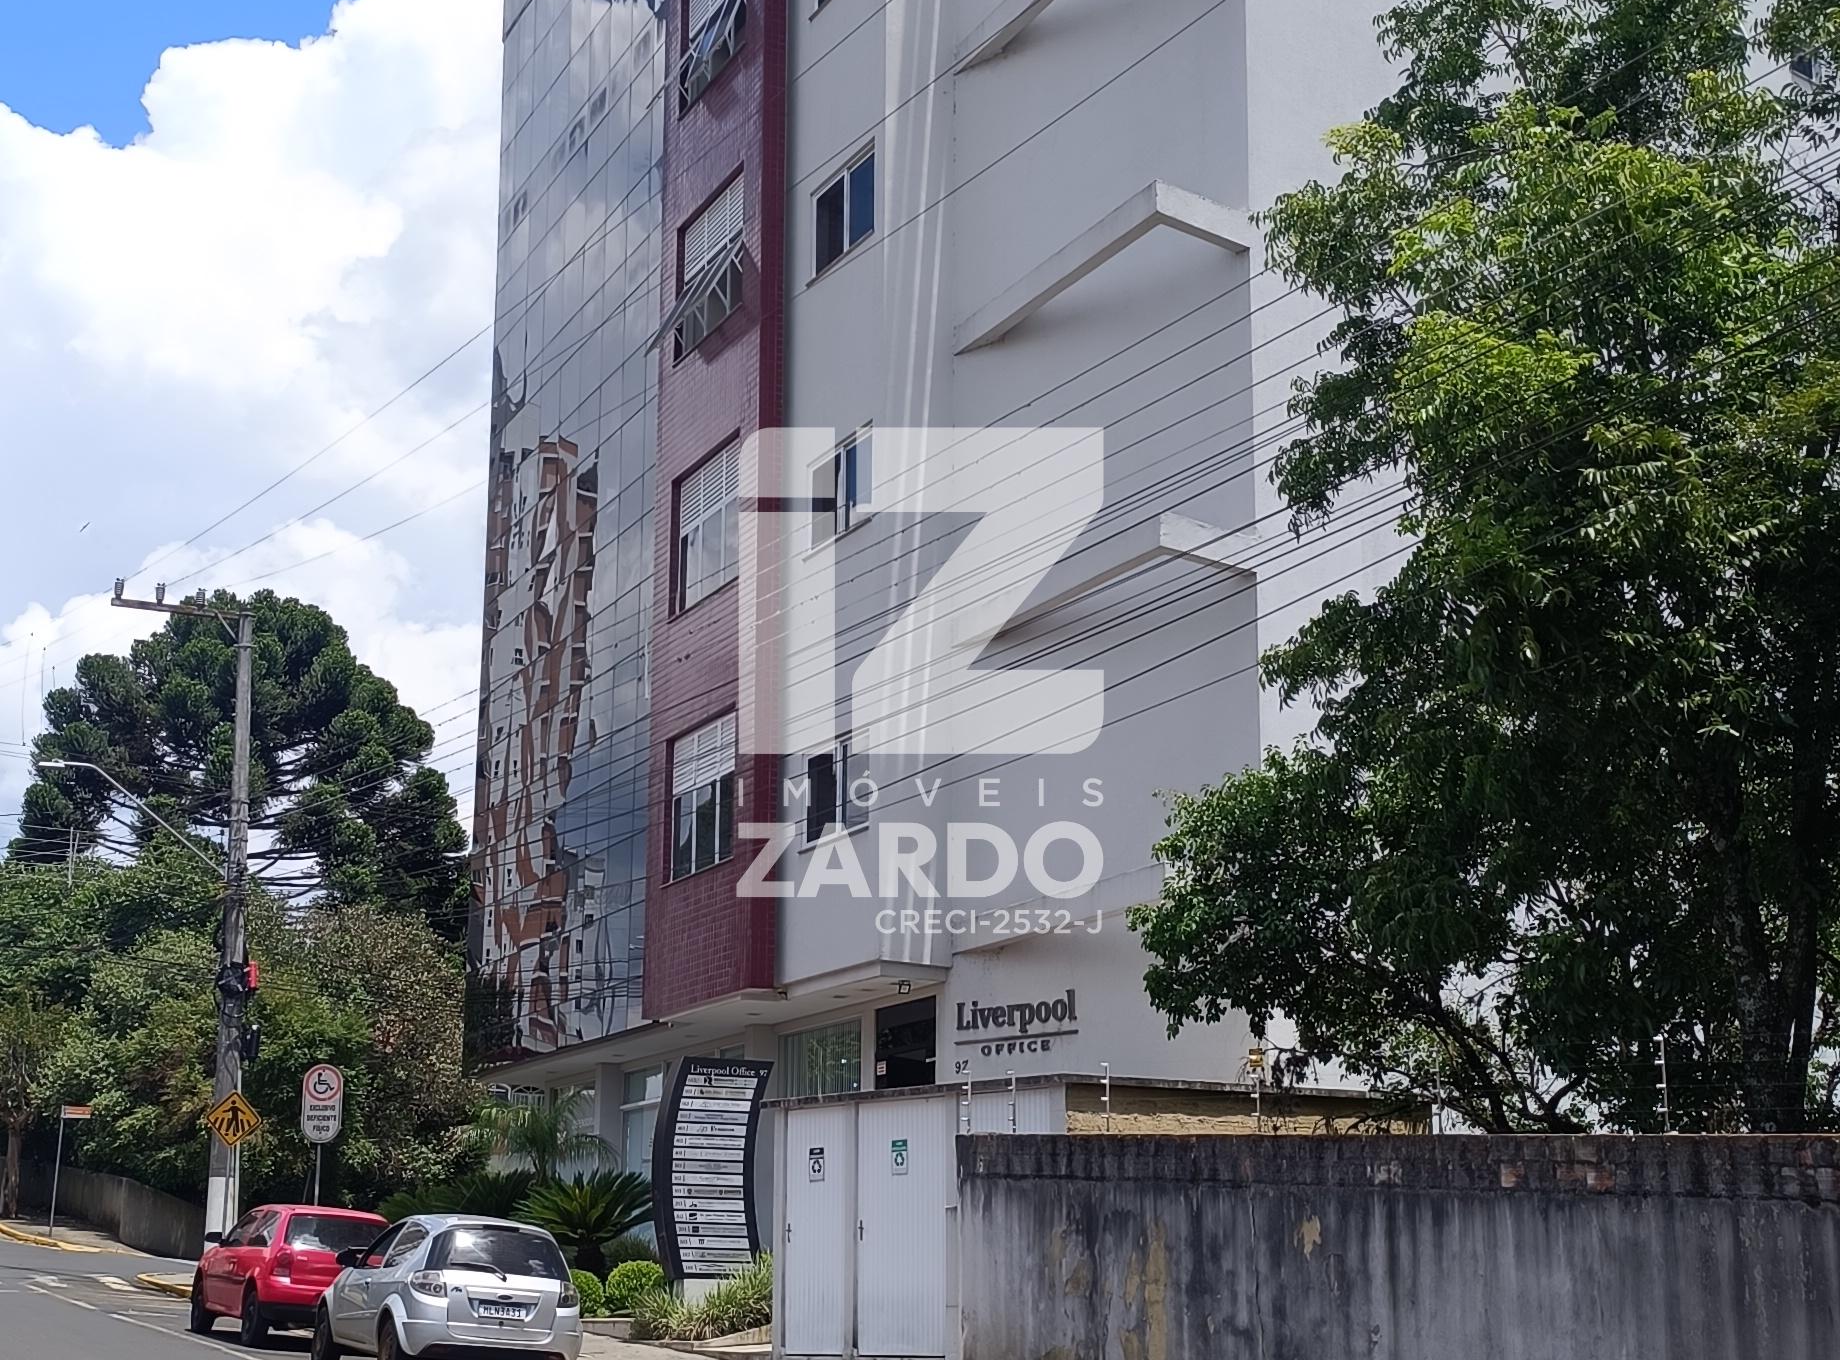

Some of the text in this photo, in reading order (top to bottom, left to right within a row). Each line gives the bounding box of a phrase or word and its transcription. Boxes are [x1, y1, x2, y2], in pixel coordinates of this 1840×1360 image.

[956, 989, 1077, 1033] Liverpool
[981, 1040, 1051, 1056] OFFICE
[691, 1064, 729, 1076] Liverpool
[731, 1066, 756, 1077] Office
